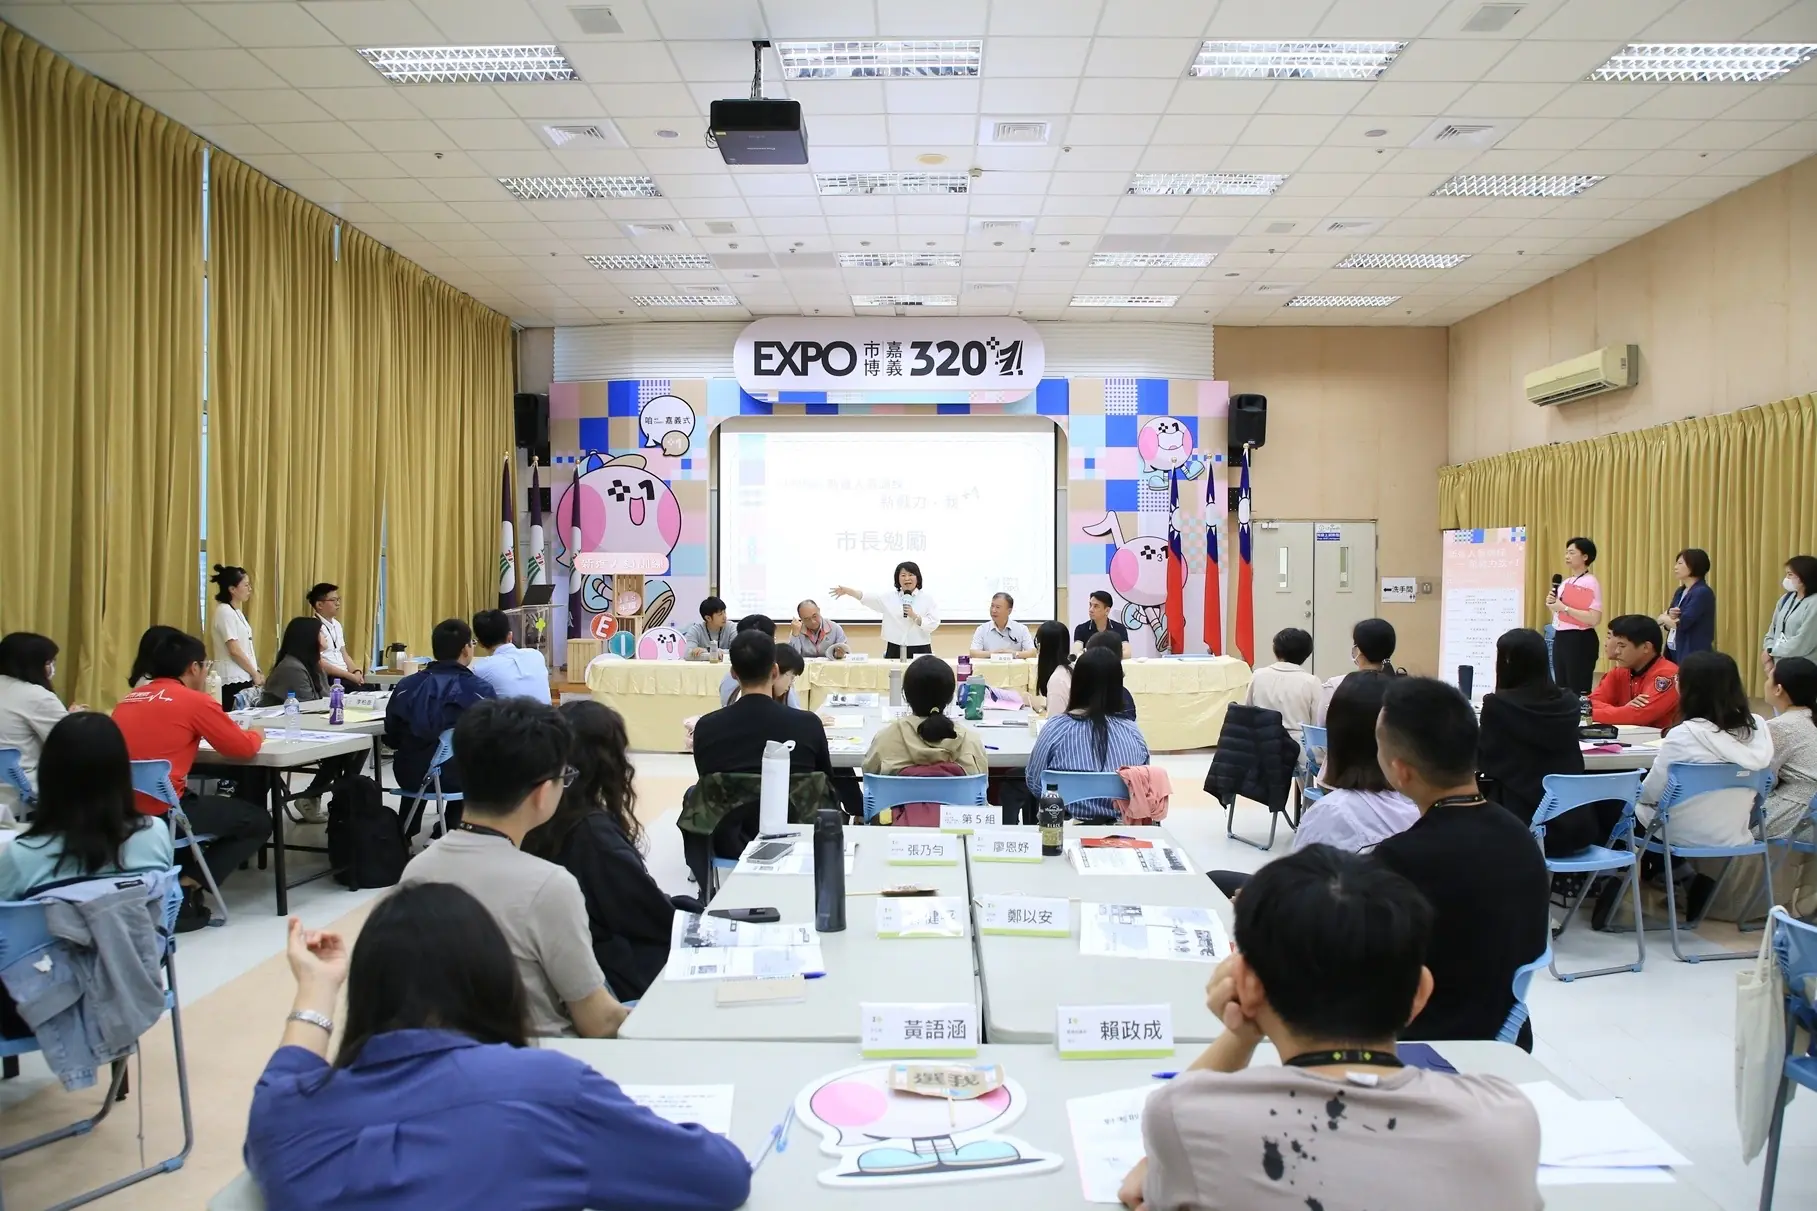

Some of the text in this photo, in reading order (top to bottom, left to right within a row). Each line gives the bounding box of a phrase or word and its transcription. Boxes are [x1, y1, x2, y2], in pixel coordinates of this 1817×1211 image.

[754, 340, 857, 376] EXPO
[863, 340, 881, 377] 市博
[886, 340, 903, 377] 嘉義
[835, 529, 928, 553] 市長勉勵
[1391, 585, 1414, 593] 洗手間
[596, 615, 613, 638] E
[1007, 908, 1053, 924] 鄭以安
[904, 1019, 966, 1040] 黃語涵
[1100, 1019, 1163, 1040] 賴政成
